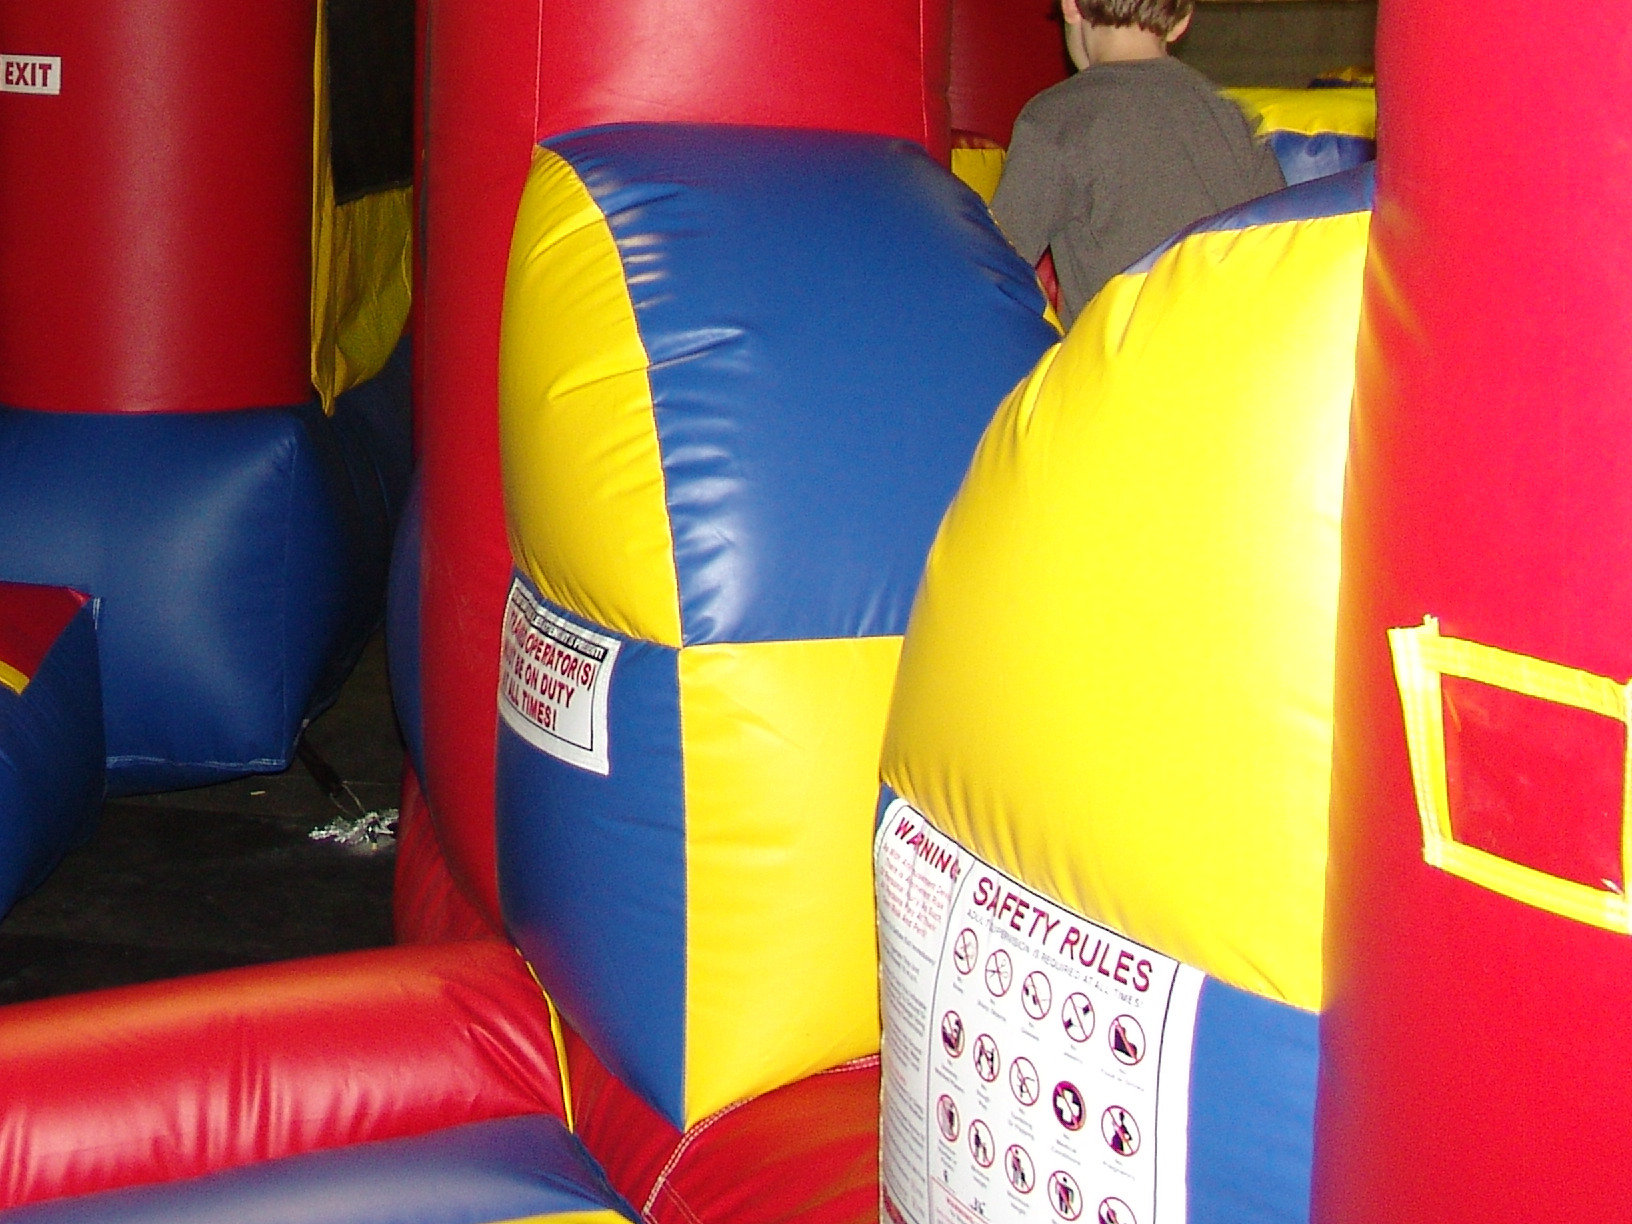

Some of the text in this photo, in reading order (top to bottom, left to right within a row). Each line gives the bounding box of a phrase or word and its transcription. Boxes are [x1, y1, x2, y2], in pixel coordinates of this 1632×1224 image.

[5, 61, 52, 87] EXIT
[524, 633, 598, 691] OPERATOR(S)
[525, 663, 539, 690] ON
[540, 672, 575, 708] DUTY
[521, 688, 557, 731] TIMES!
[973, 876, 1061, 945] SAFETY
[1058, 926, 1154, 992] RULES
